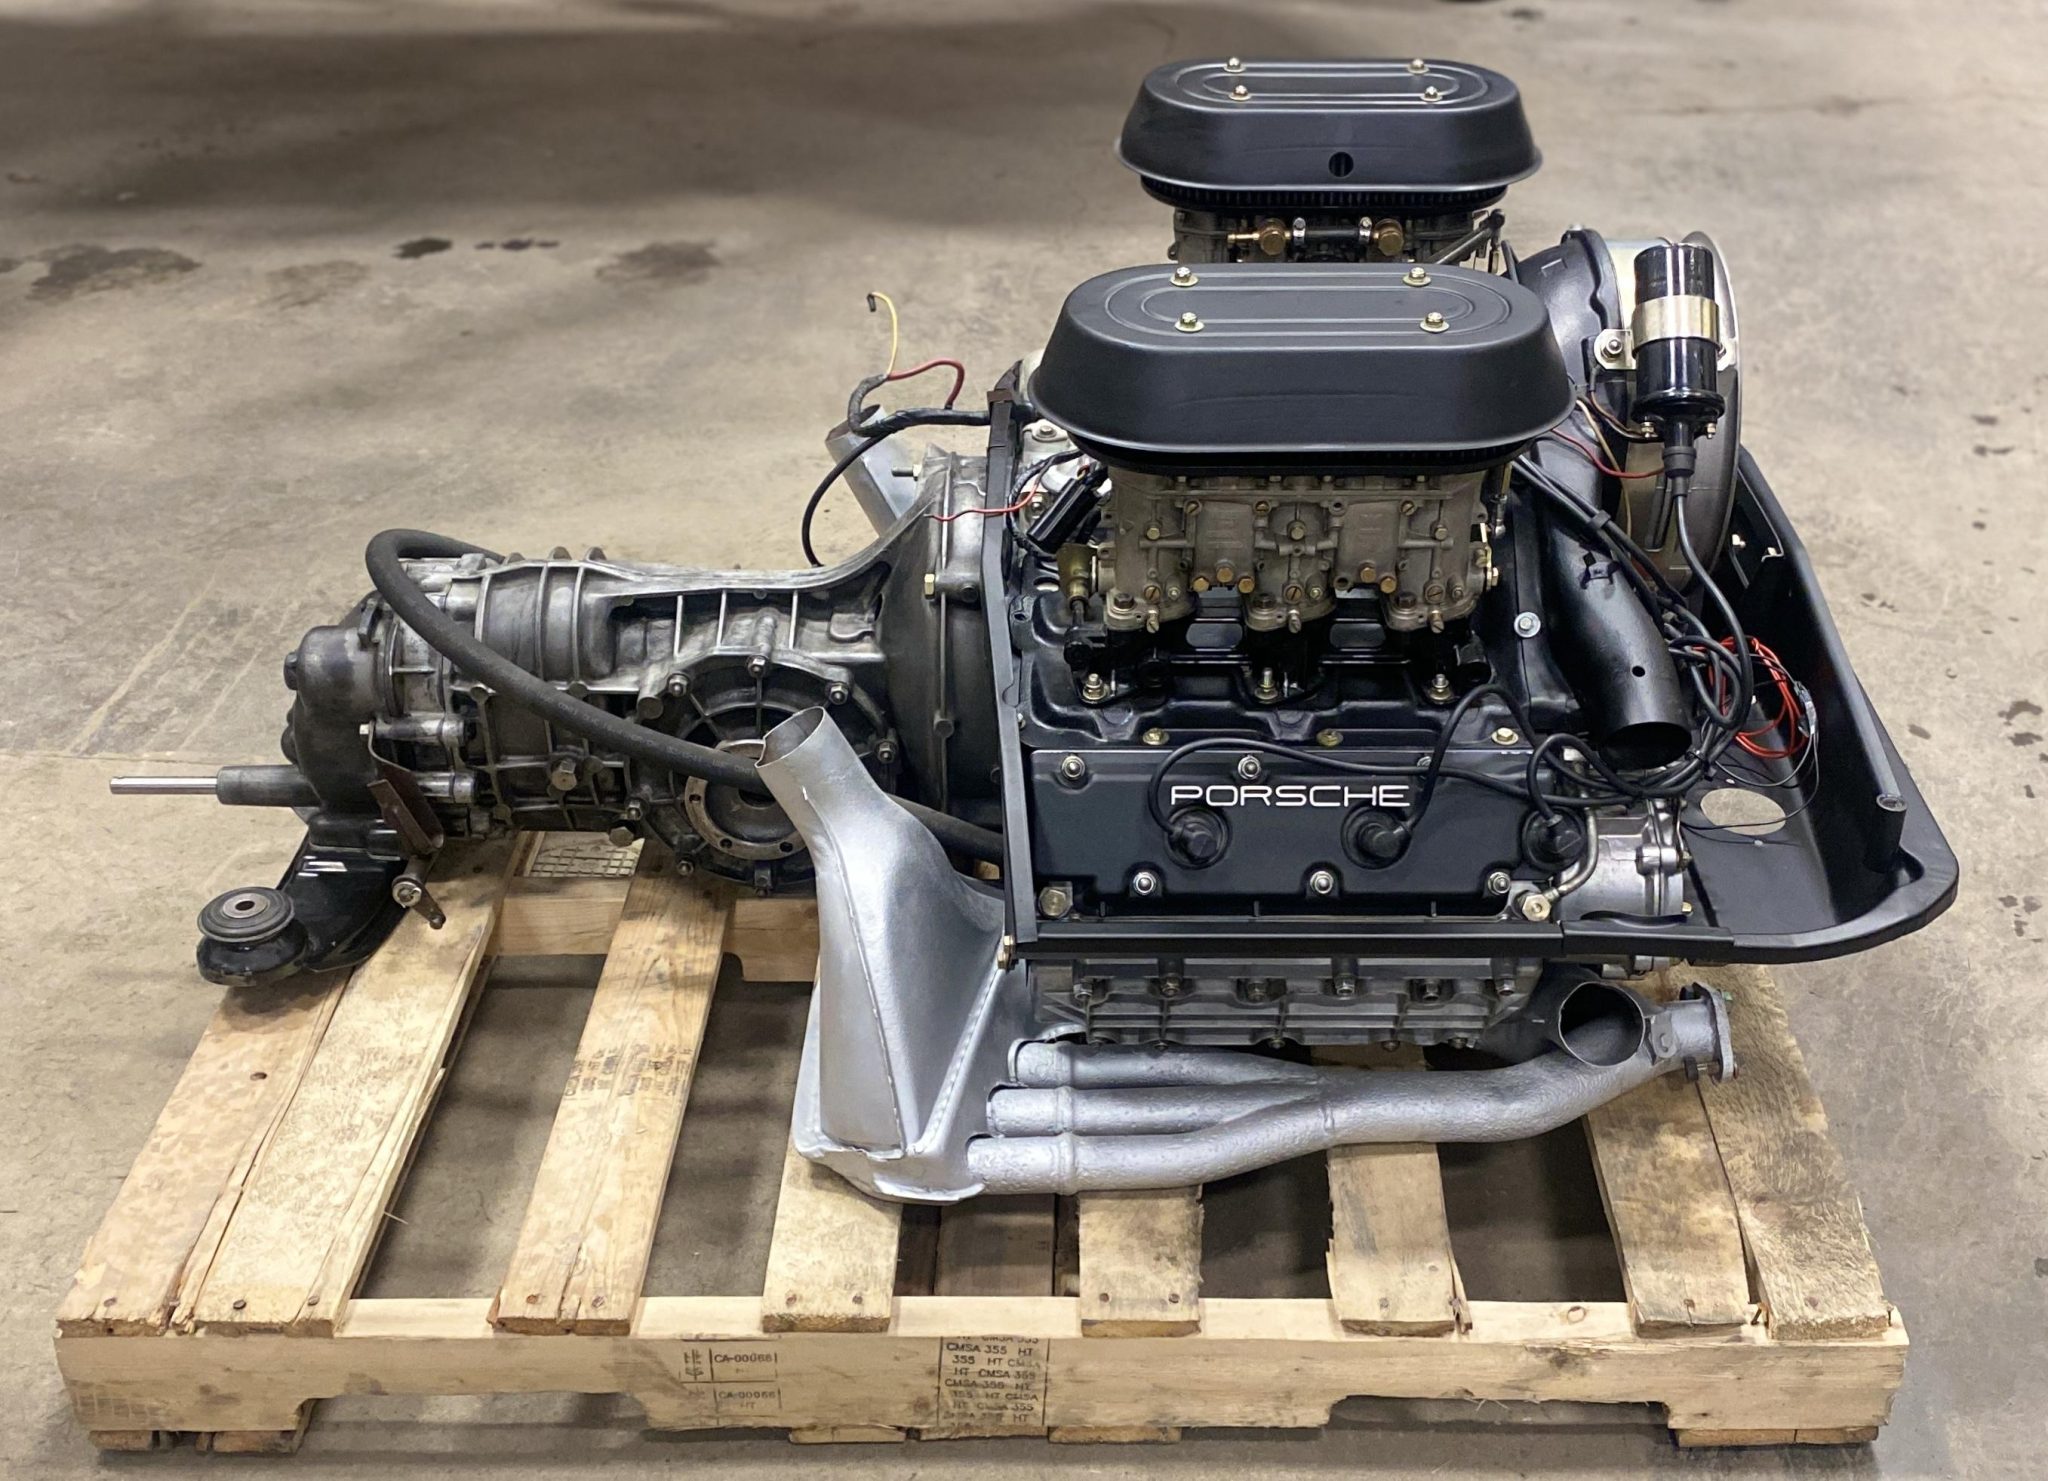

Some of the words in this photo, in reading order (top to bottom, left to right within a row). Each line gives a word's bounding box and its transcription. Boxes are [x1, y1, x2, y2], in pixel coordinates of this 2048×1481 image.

[1171, 785, 1410, 807] PORSCHE
[946, 1342, 981, 1353] CMSA
[984, 1344, 1007, 1355] 355
[1018, 1347, 1033, 1356] HT
[952, 1354, 975, 1364] 355
[987, 1358, 1003, 1366] HT
[978, 1368, 1010, 1378] CMSA
